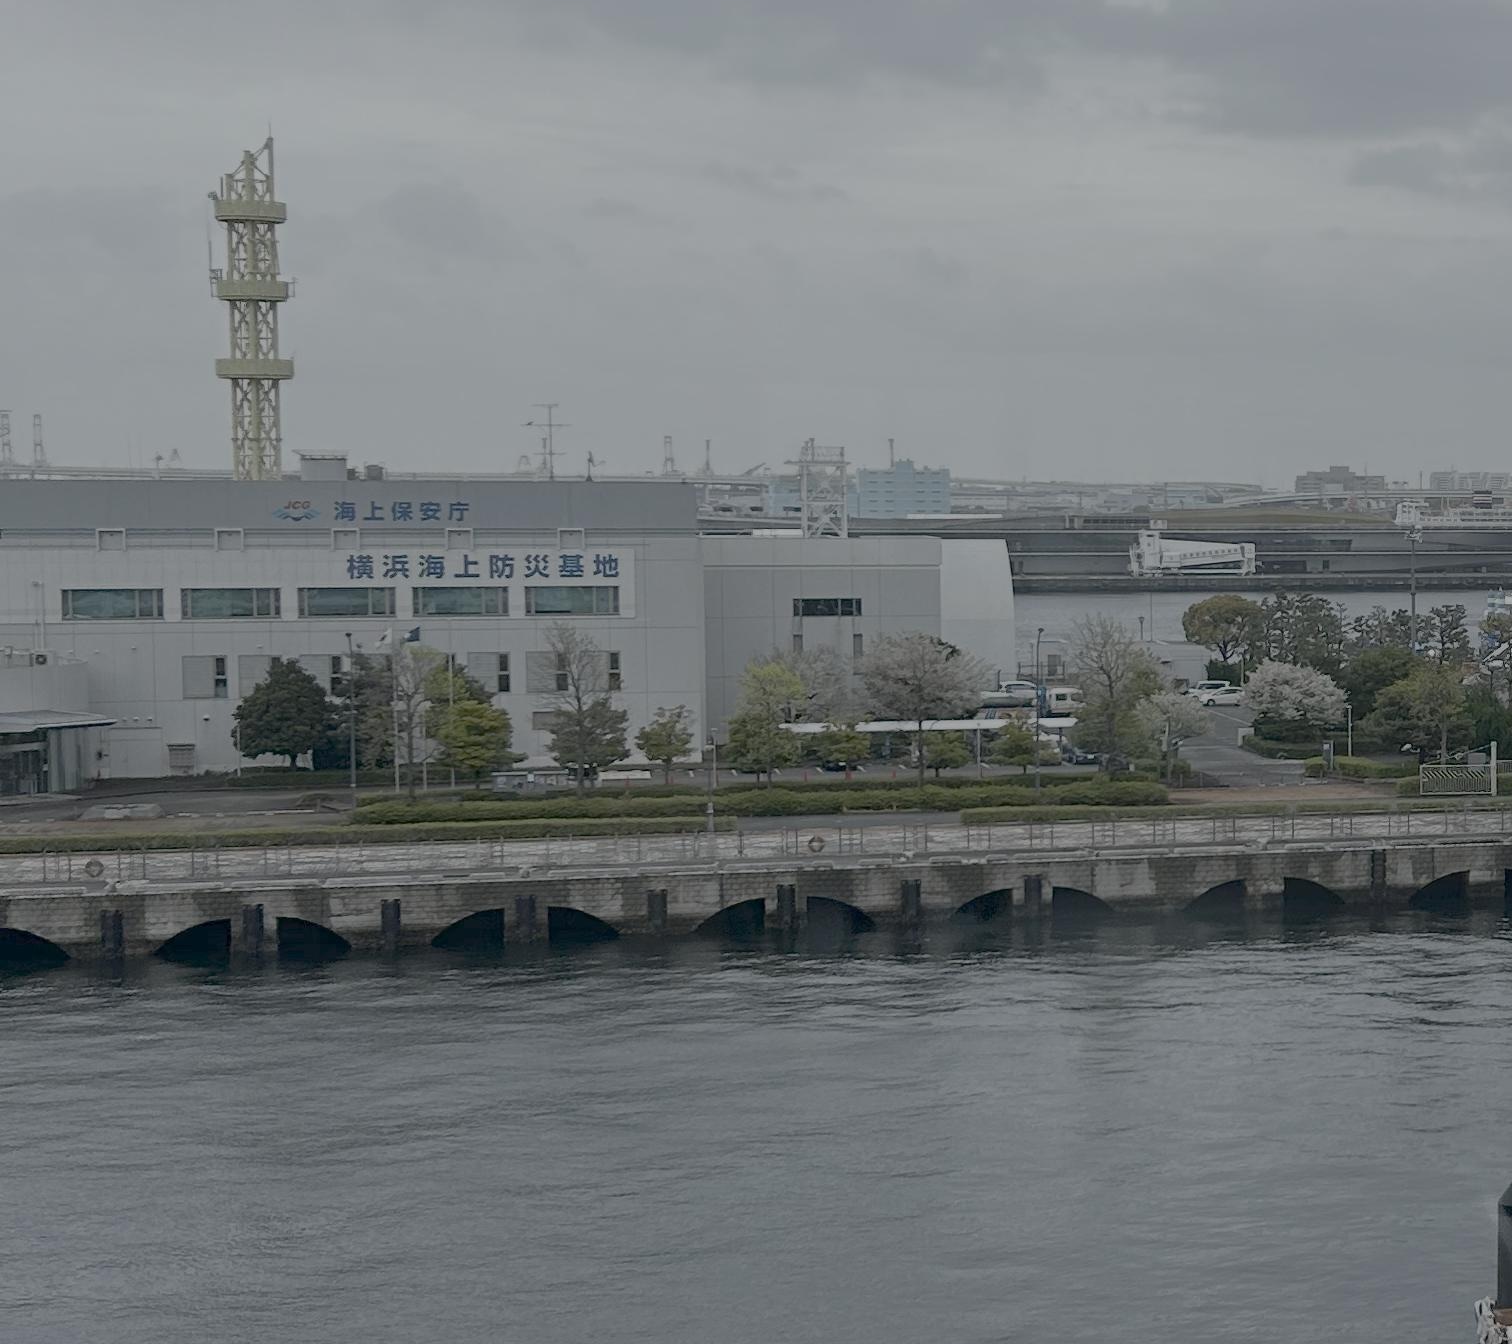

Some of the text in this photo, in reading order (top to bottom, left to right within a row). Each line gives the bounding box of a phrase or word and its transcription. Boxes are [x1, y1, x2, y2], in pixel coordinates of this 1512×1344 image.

[284, 500, 312, 510] JCG
[334, 501, 470, 522] 海上保安庁
[347, 554, 620, 580] 横浜海上防災基地
